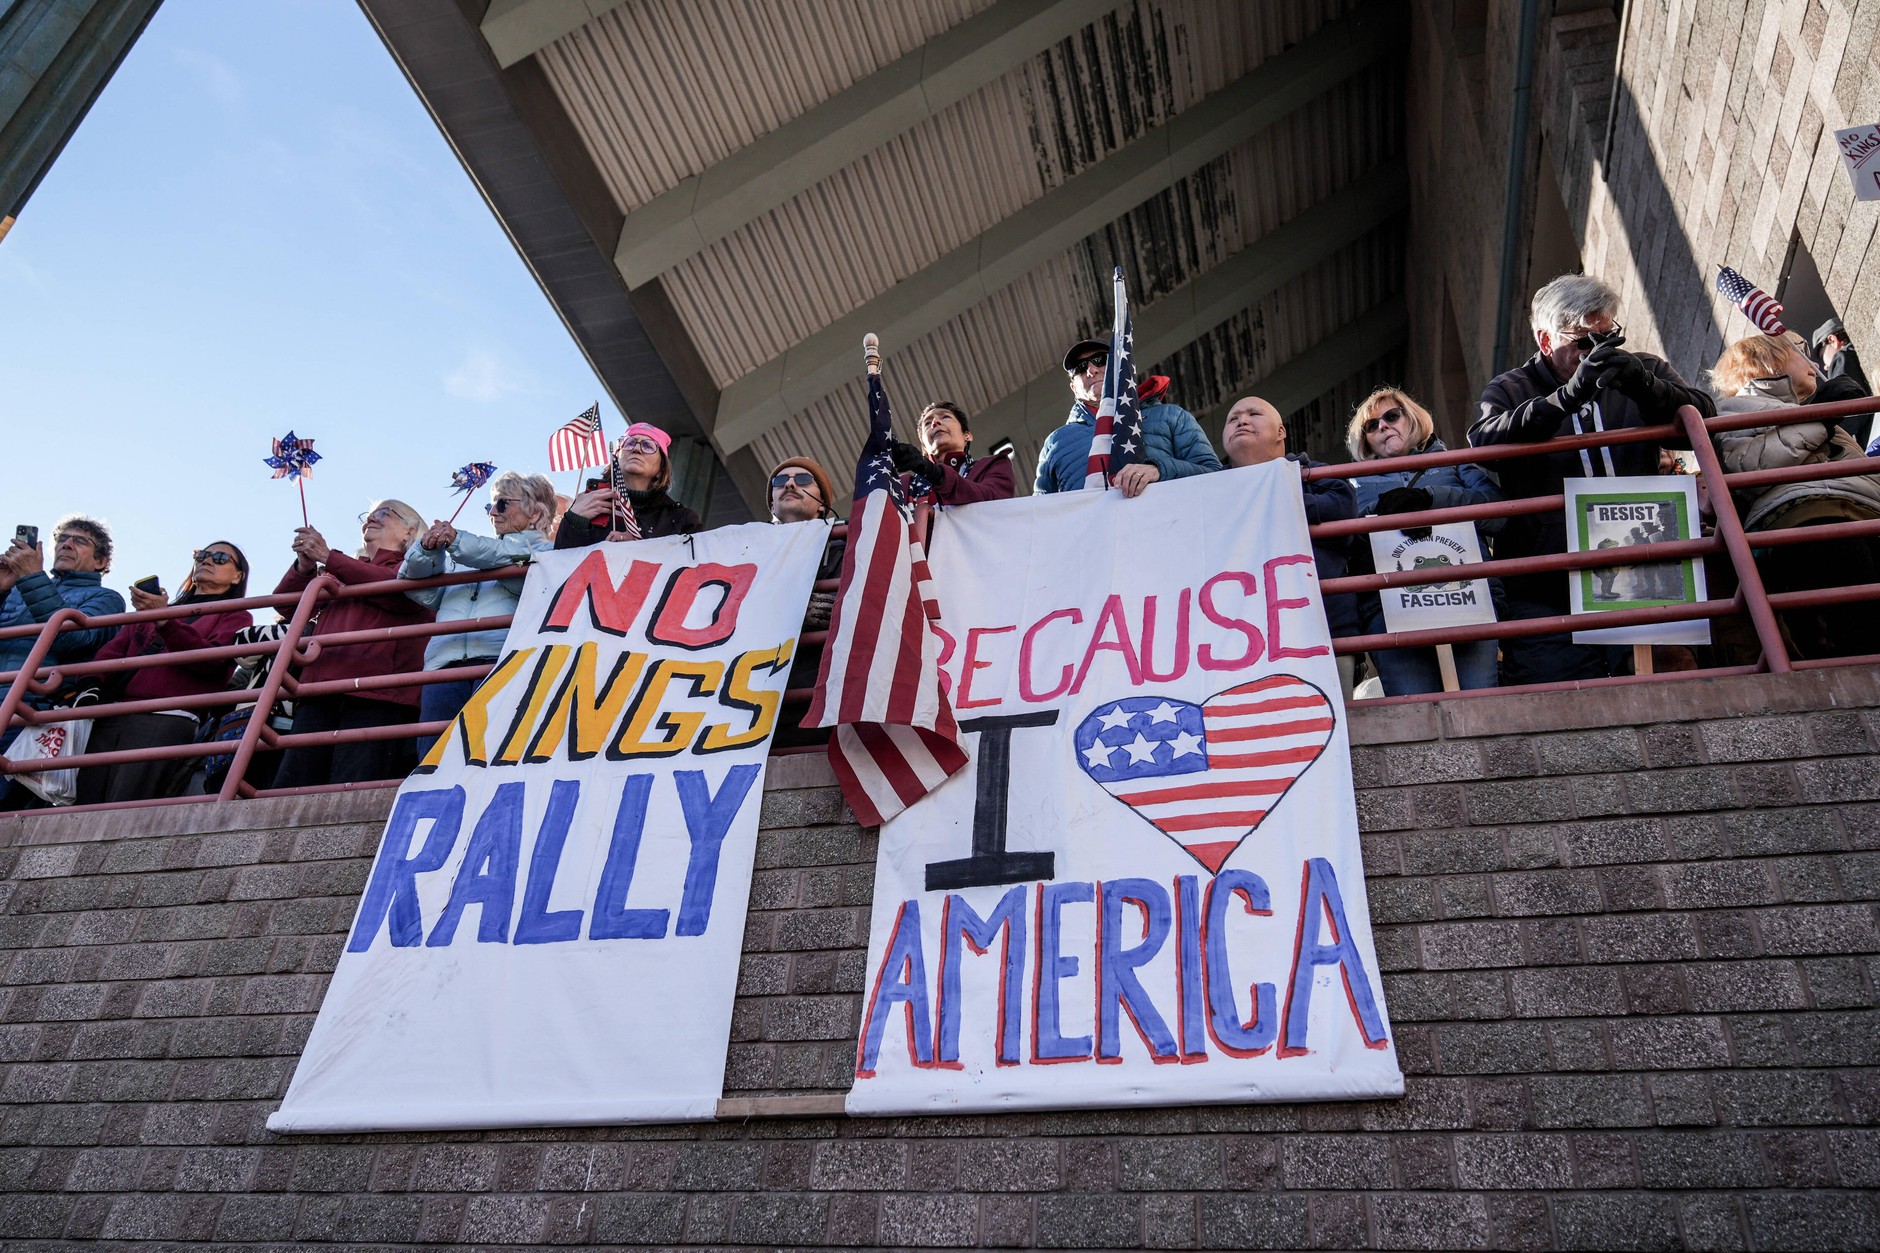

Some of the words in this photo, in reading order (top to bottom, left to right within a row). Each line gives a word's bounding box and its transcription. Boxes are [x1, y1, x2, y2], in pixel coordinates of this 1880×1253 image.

[1840, 133, 1859, 149] NO
[1845, 132, 1880, 161] KINGS
[1599, 506, 1655, 521] RESIST
[1392, 543, 1406, 559] ONLY
[1435, 535, 1466, 555] PREVENT
[538, 550, 758, 651] NO
[1400, 590, 1476, 609] FASCISM
[411, 638, 794, 775] KINGS
[925, 709, 1060, 891] I
[347, 763, 762, 953] RALLY
[856, 857, 1389, 1078] AMERICA
